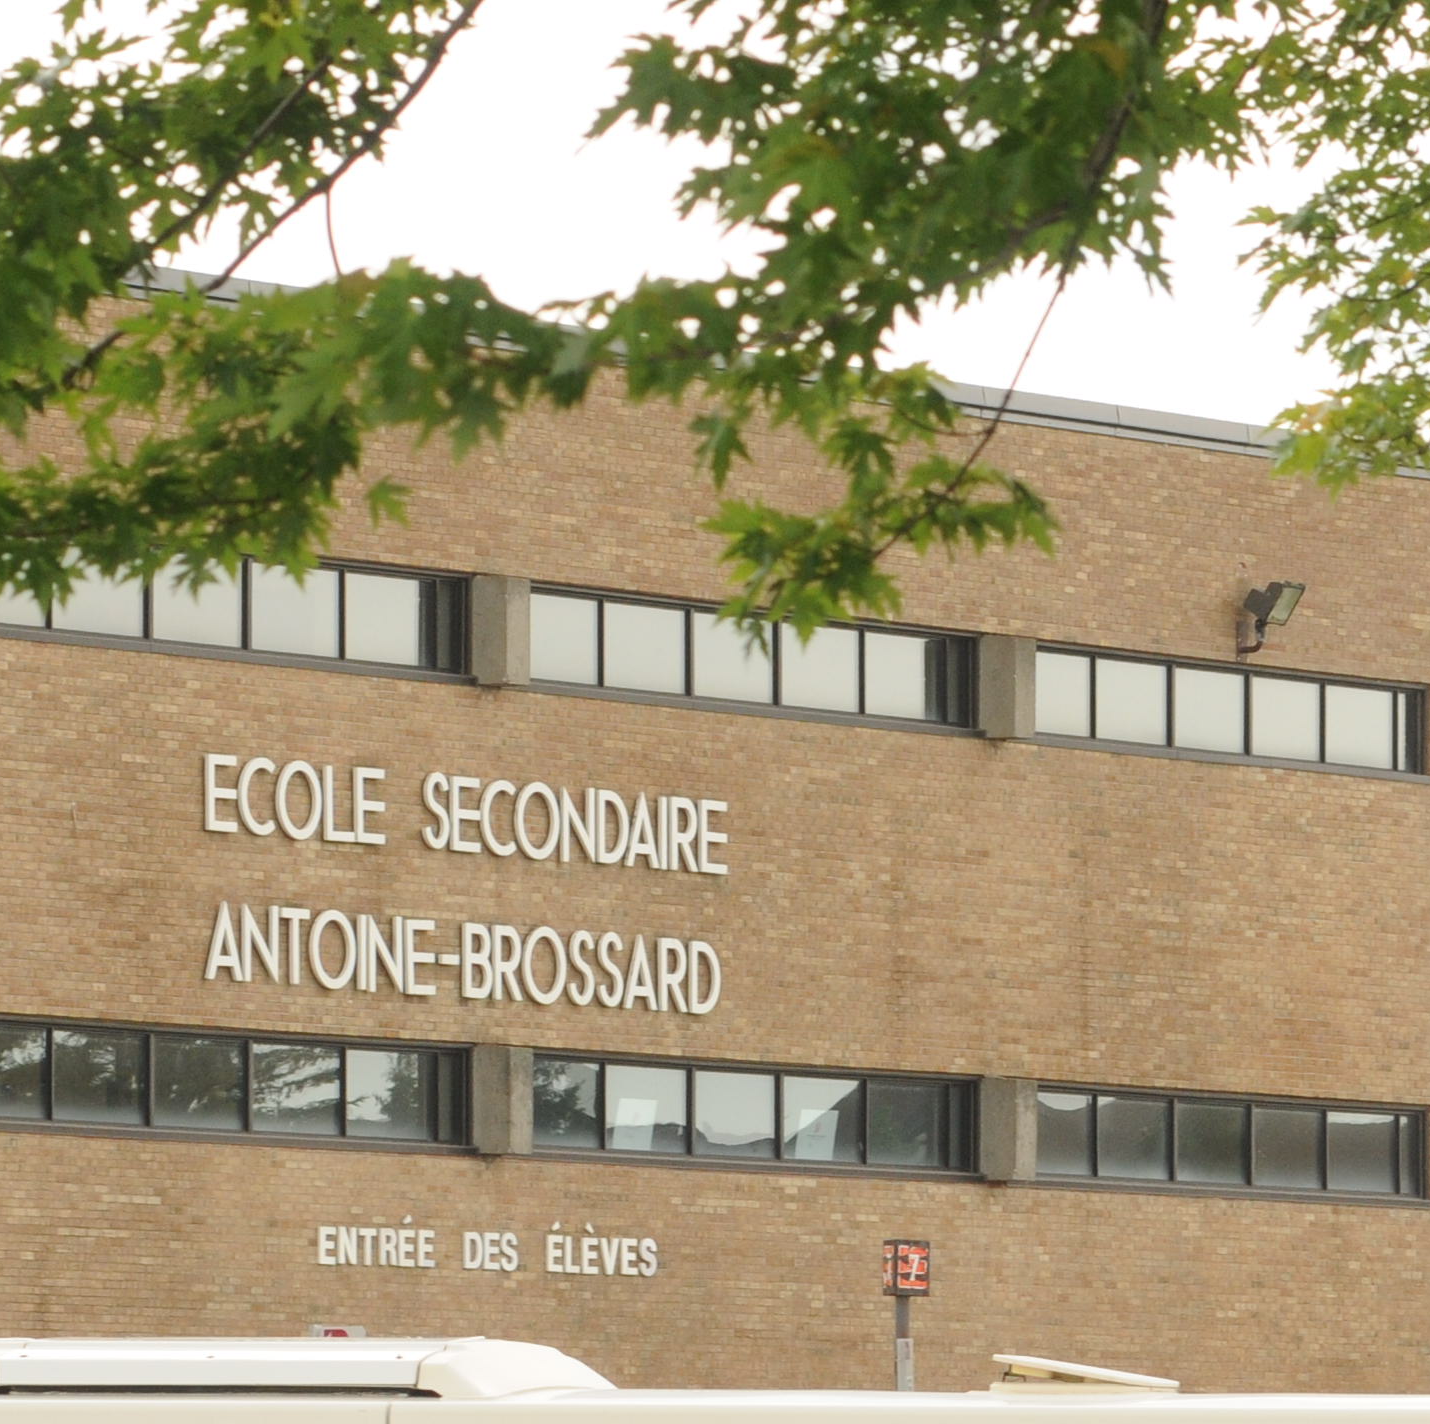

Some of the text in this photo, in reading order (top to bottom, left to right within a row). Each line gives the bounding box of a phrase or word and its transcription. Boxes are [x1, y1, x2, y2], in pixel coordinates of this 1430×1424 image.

[204, 753, 729, 875] ECOLE SECONDAIRE
[204, 900, 722, 1015] ANTOINE-BROSSARD
[318, 1214, 659, 1277] ENTRÉE DES ÉLÈVES
[908, 1254, 920, 1281] 7
